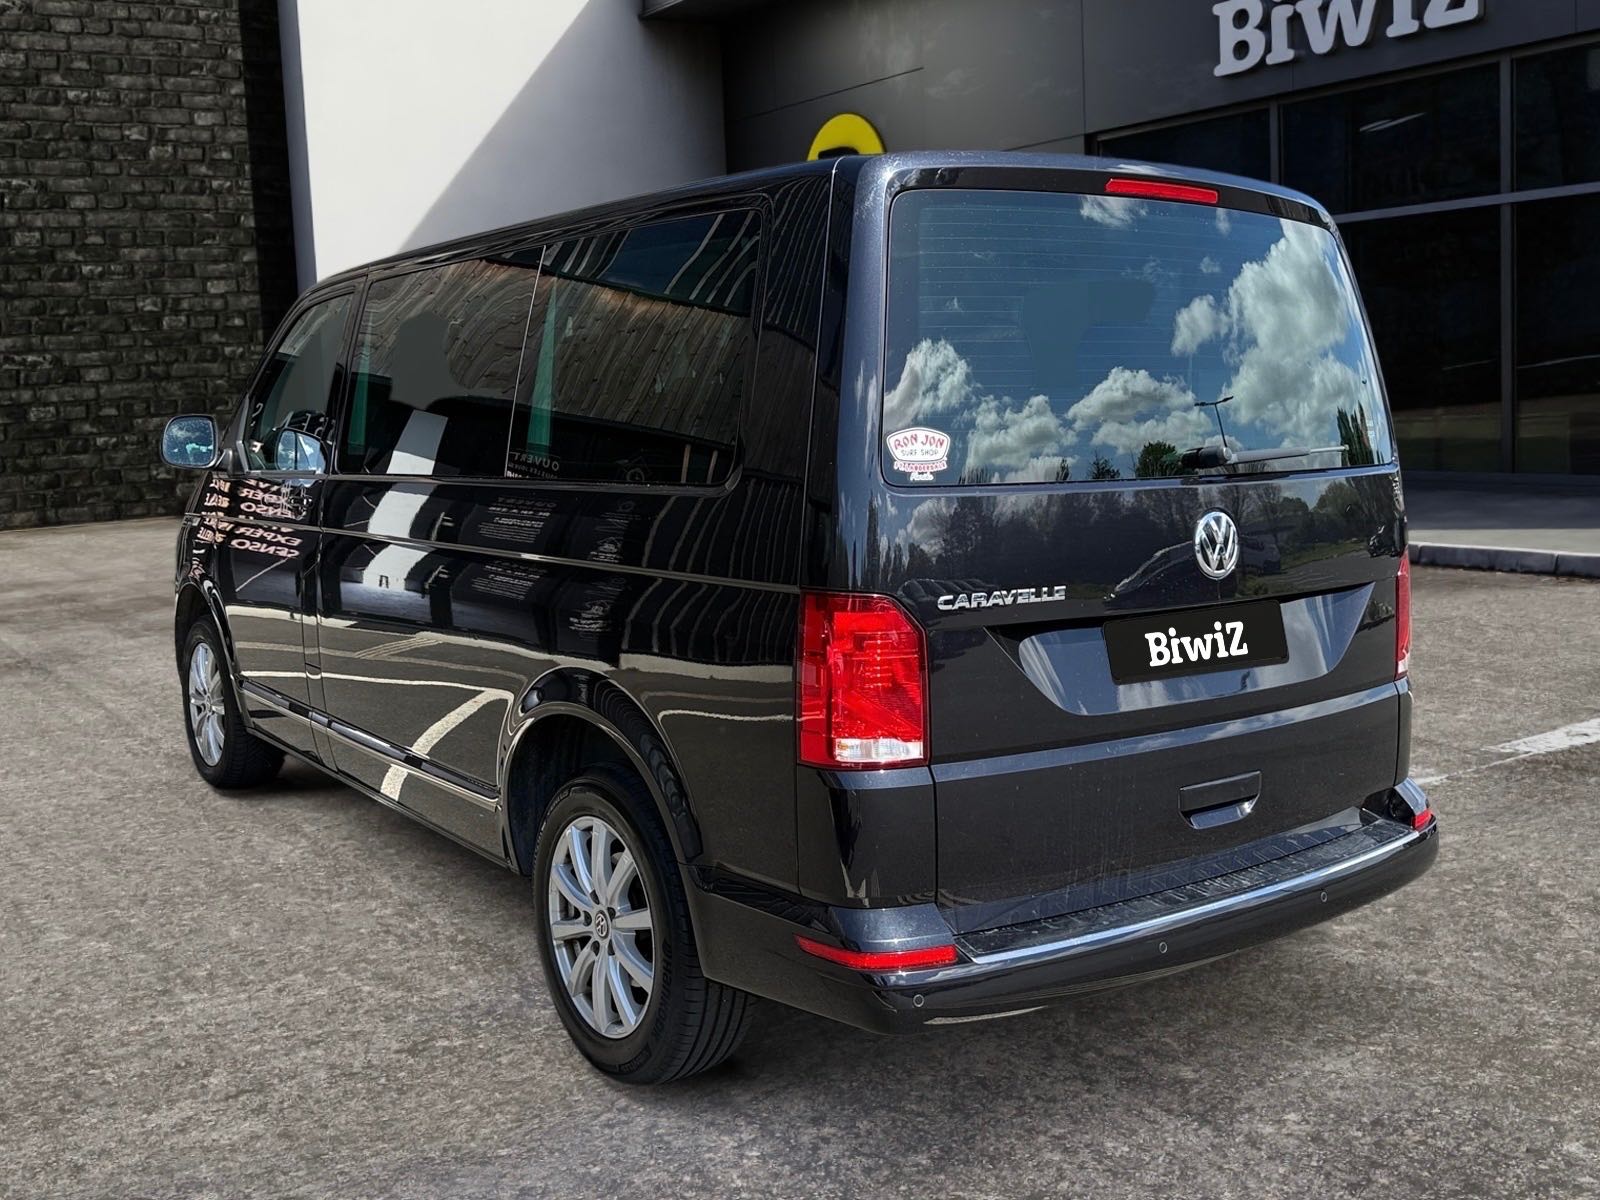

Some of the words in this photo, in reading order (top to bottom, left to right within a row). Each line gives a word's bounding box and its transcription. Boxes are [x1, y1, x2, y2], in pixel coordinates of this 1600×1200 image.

[894, 433, 918, 450] RON
[921, 434, 945, 448] JON
[937, 585, 1067, 611] CARAVELLE
[1145, 621, 1249, 667] BiwiZ
